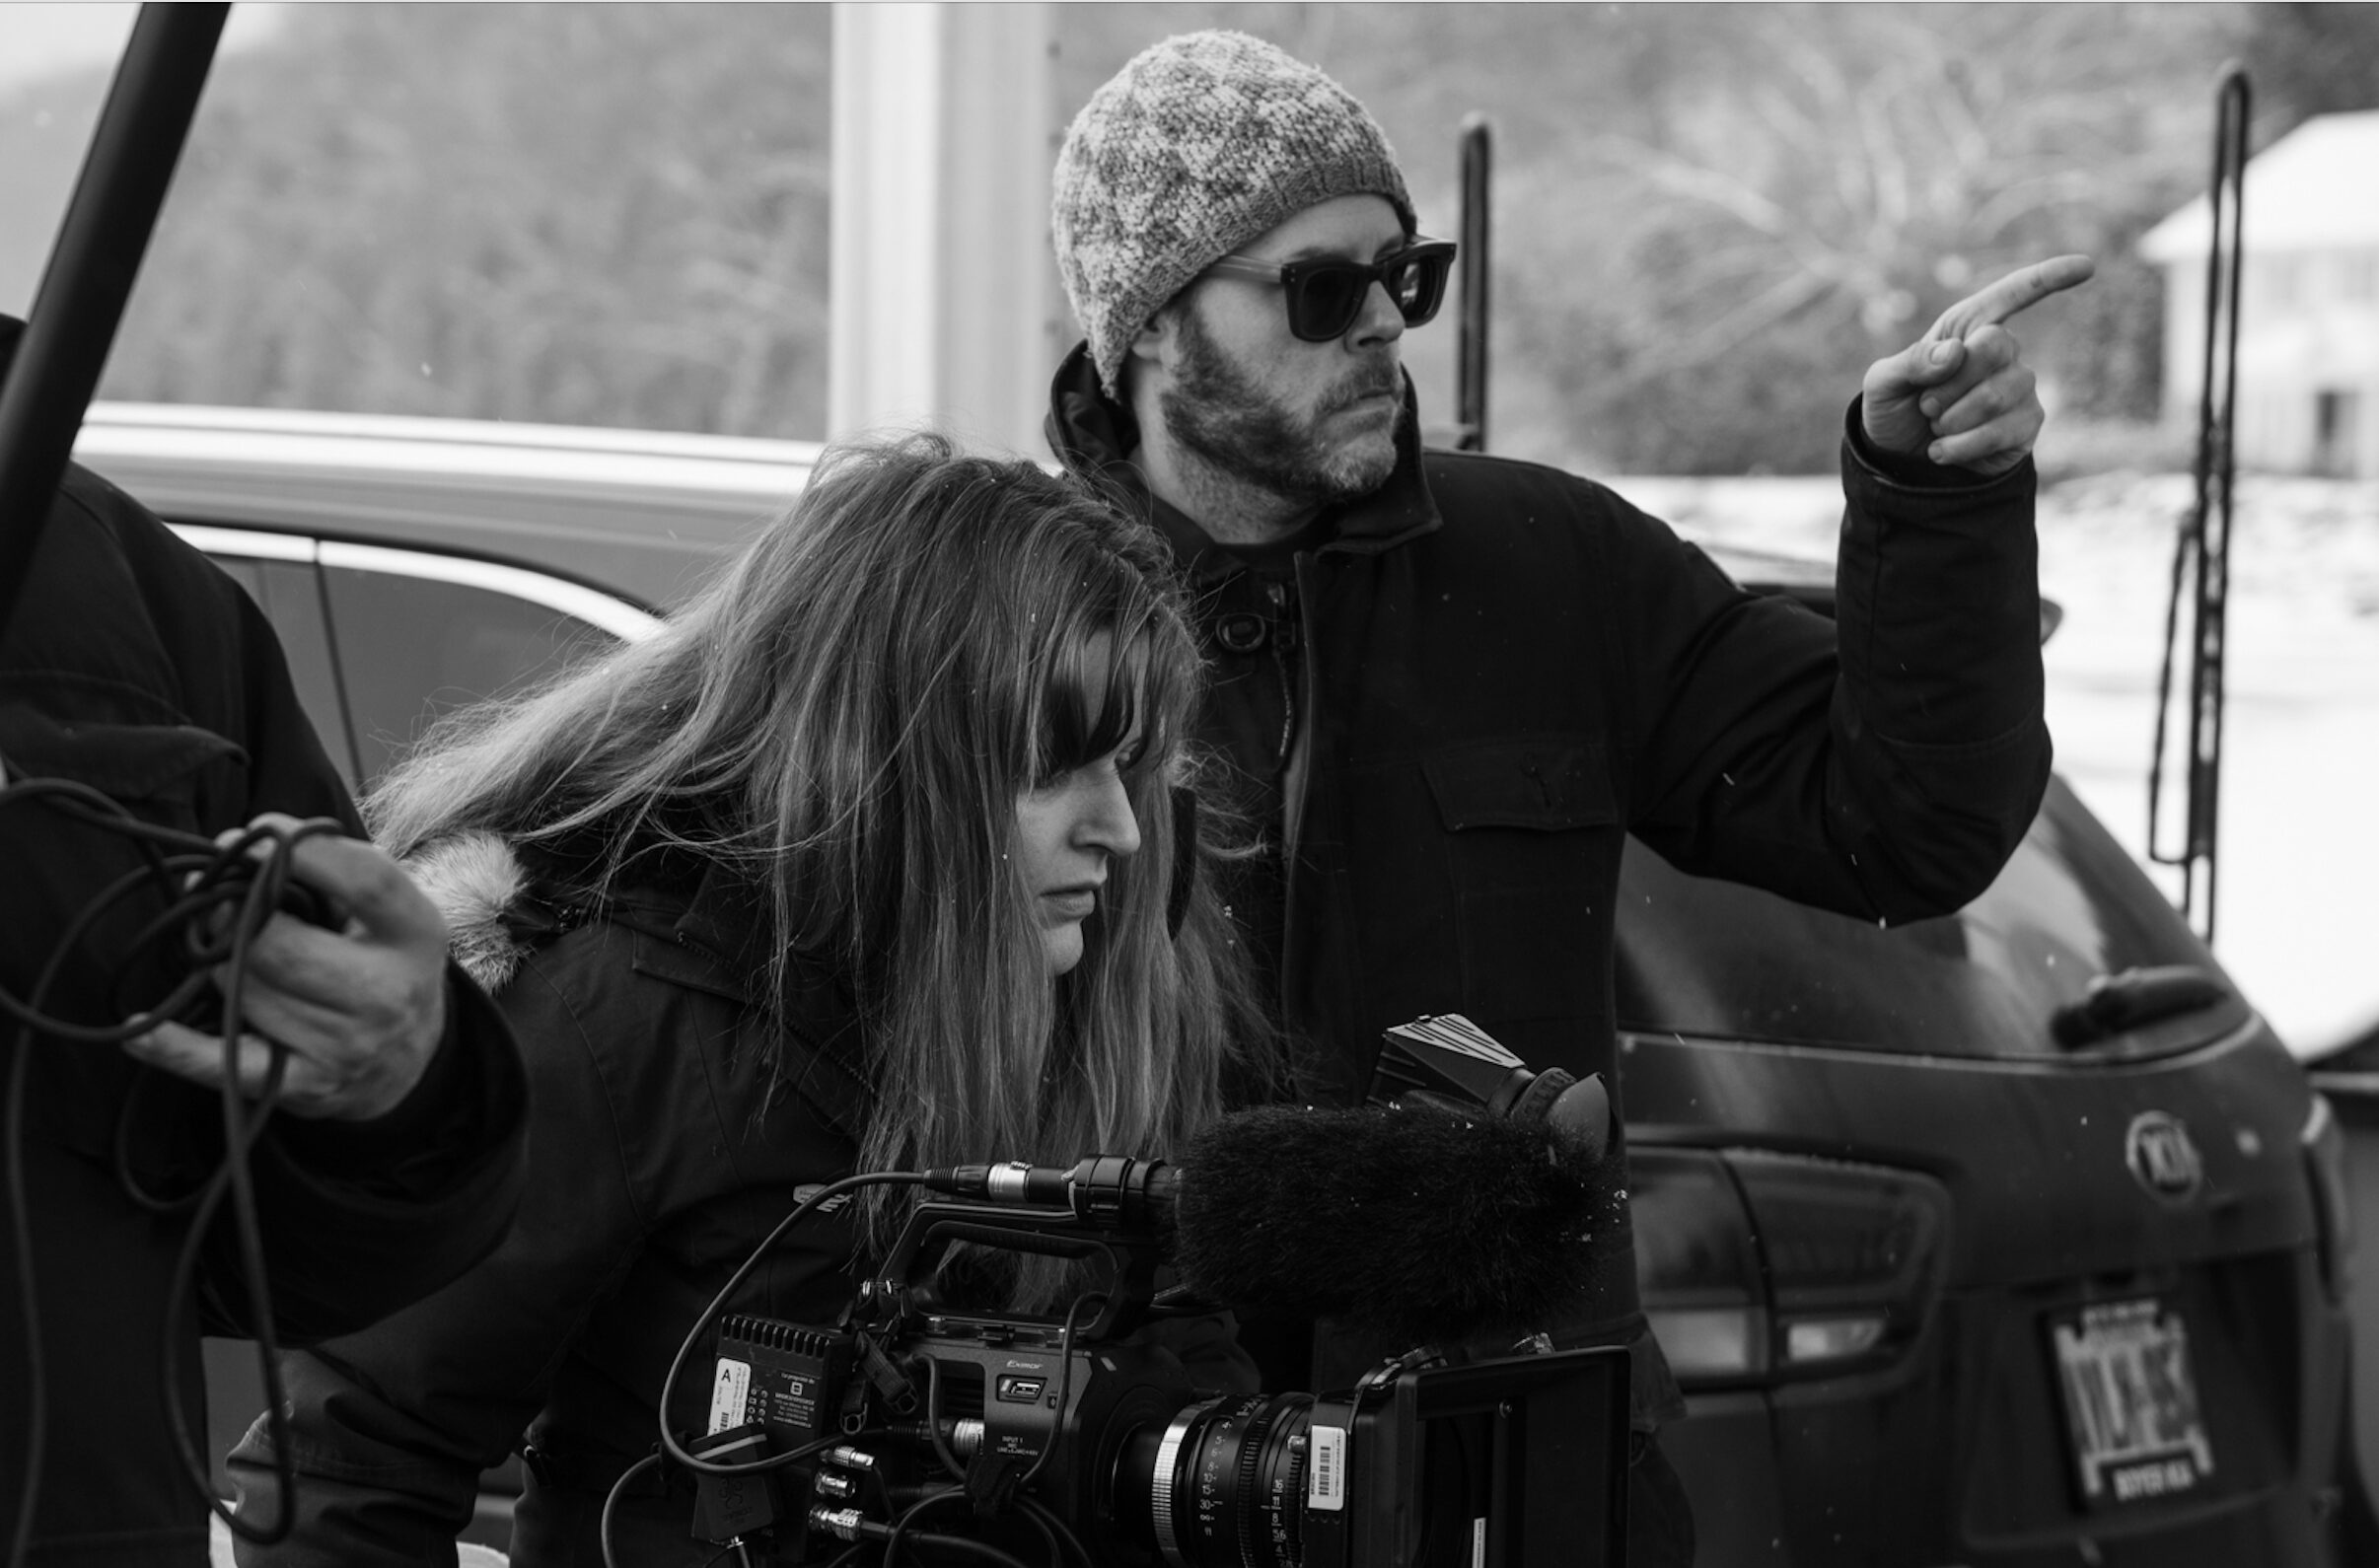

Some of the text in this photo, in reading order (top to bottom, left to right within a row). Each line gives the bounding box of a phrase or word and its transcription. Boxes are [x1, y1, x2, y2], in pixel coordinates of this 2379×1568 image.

[721, 1369, 731, 1383] A
[1199, 1499, 1212, 1511] 30
[1272, 1512, 1279, 1523] 8
